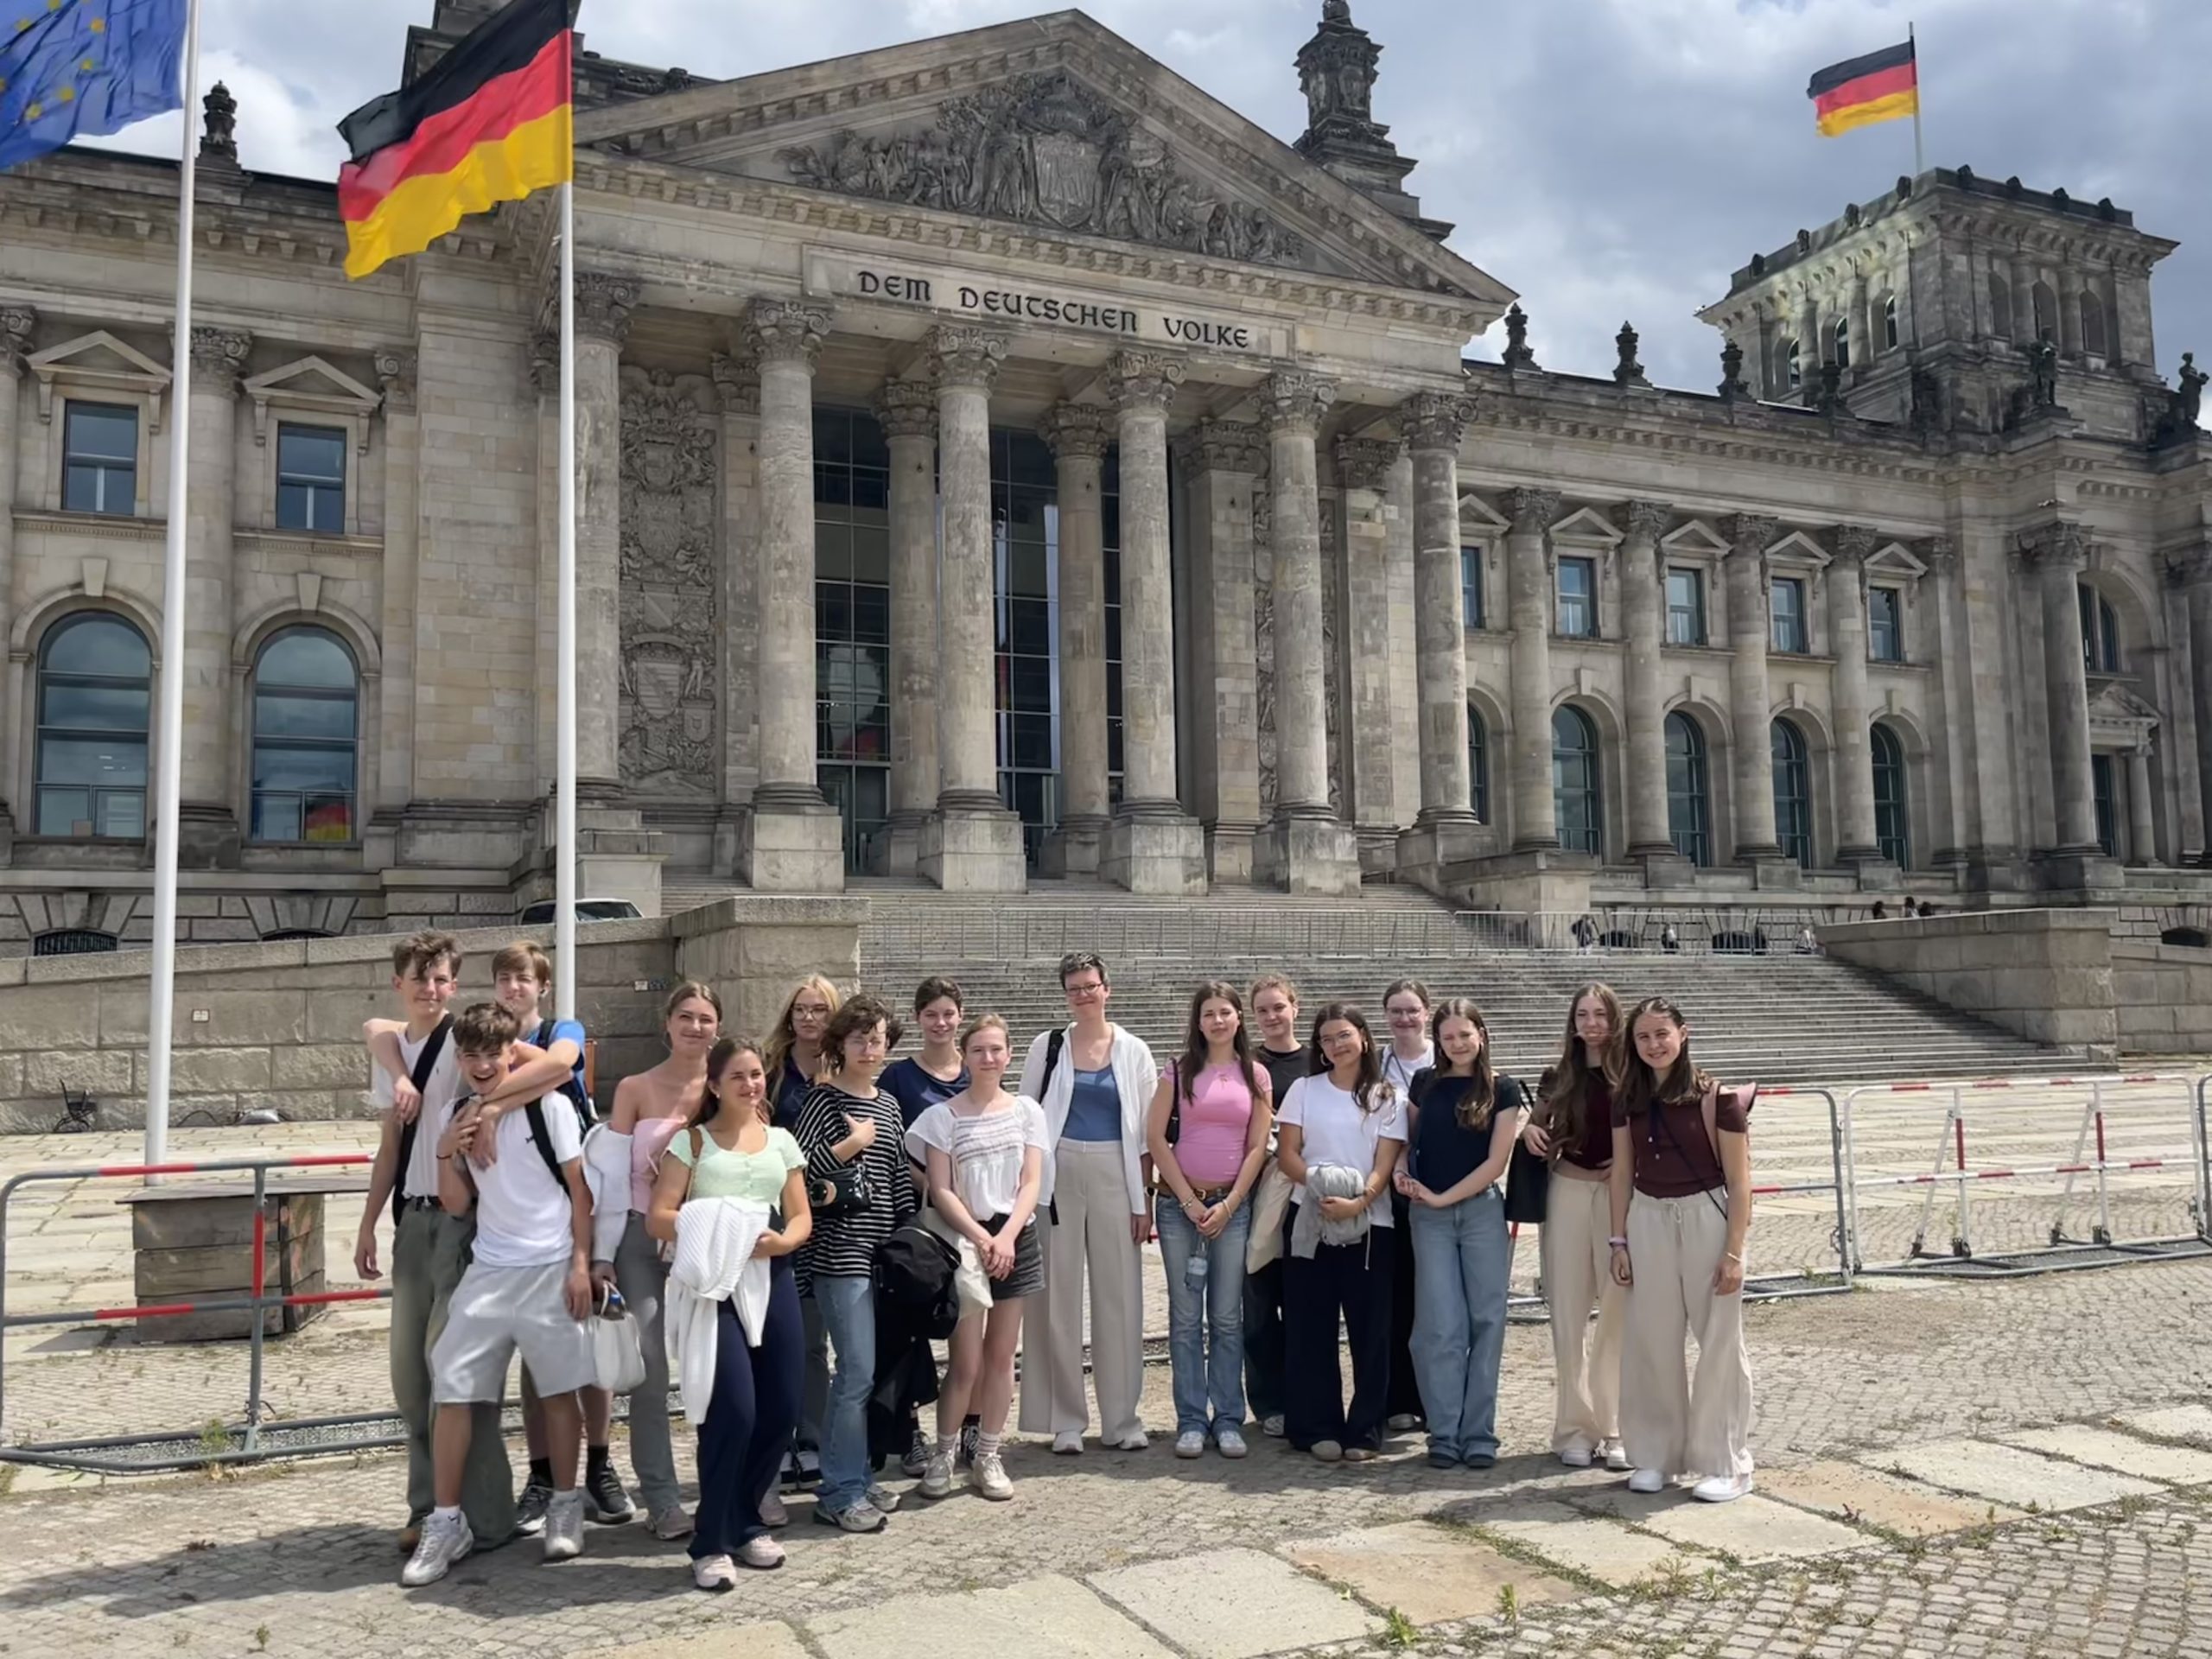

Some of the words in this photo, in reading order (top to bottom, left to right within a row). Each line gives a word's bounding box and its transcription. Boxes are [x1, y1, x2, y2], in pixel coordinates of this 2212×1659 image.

[858, 270, 931, 302] DEM
[958, 287, 1137, 332] DEUTSCHEN
[1163, 317, 1249, 348] VOLKE
